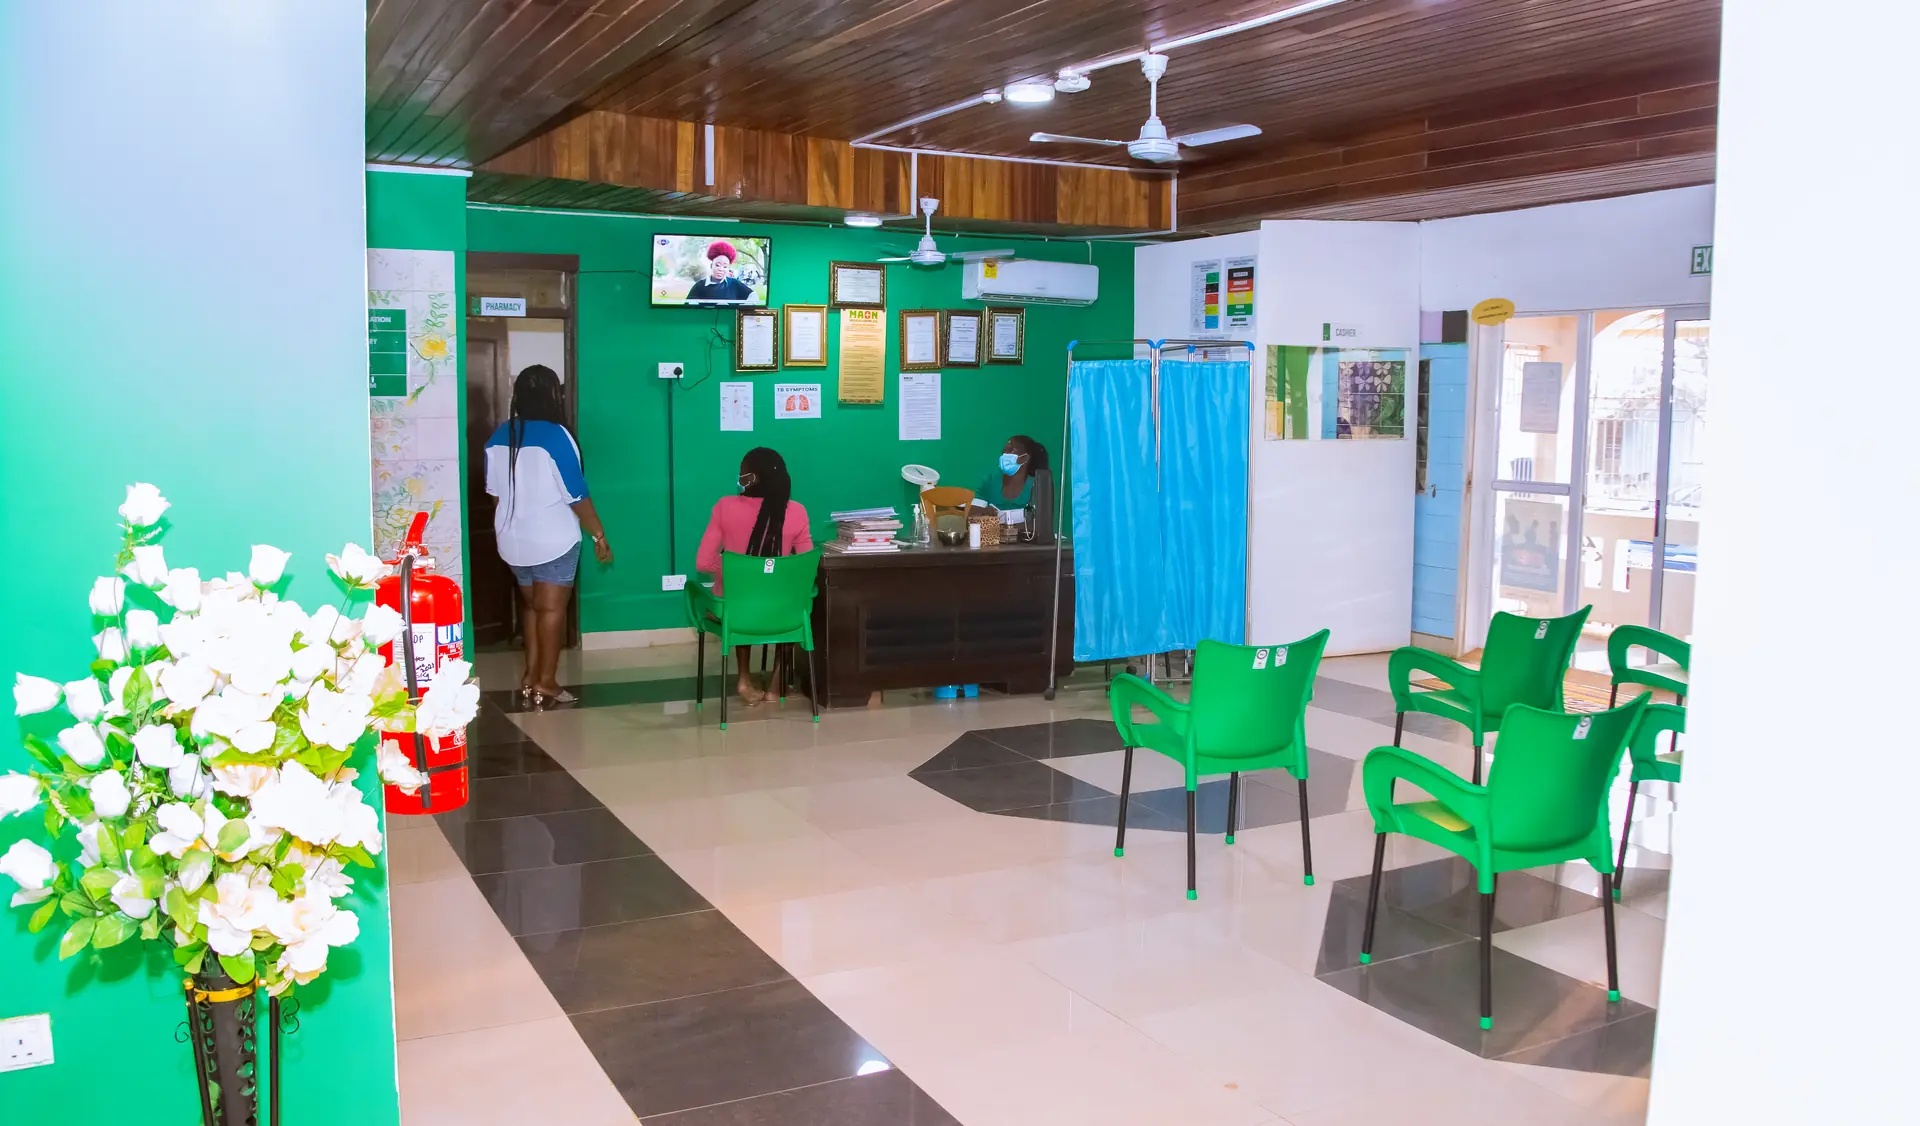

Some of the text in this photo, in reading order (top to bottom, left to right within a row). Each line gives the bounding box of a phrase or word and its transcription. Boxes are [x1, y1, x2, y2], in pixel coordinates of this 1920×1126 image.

[1695, 248, 1711, 273] EX
[485, 302, 521, 311] PHARMACY
[849, 310, 878, 320] MAON
[1335, 328, 1356, 337] CASHIER
